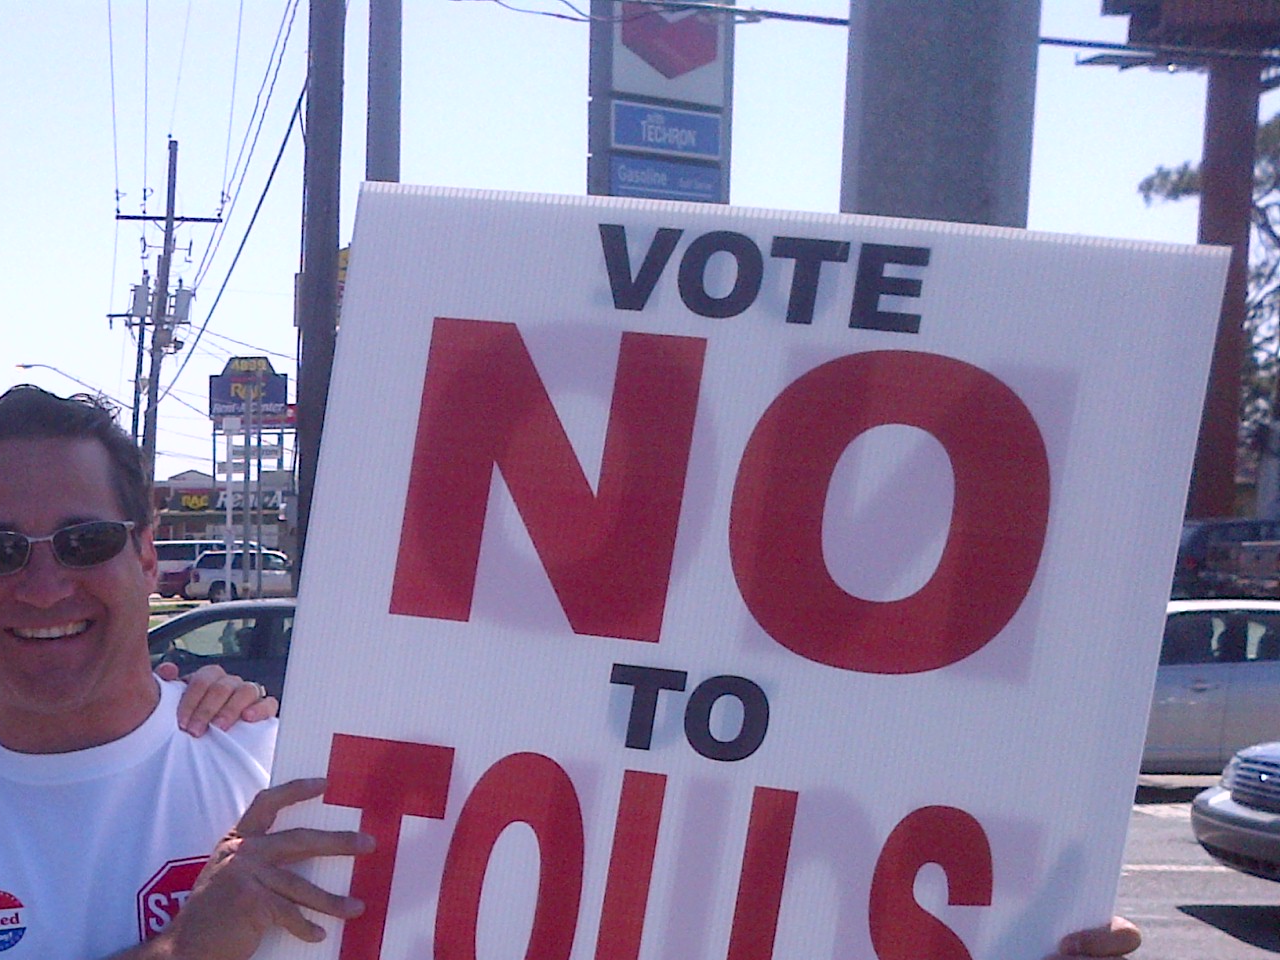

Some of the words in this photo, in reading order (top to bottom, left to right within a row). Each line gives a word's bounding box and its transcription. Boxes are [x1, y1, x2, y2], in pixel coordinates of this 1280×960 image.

[600, 224, 930, 334] VOTE
[389, 317, 1050, 676] NO
[609, 662, 771, 762] TO
[147, 890, 193, 934] ST
